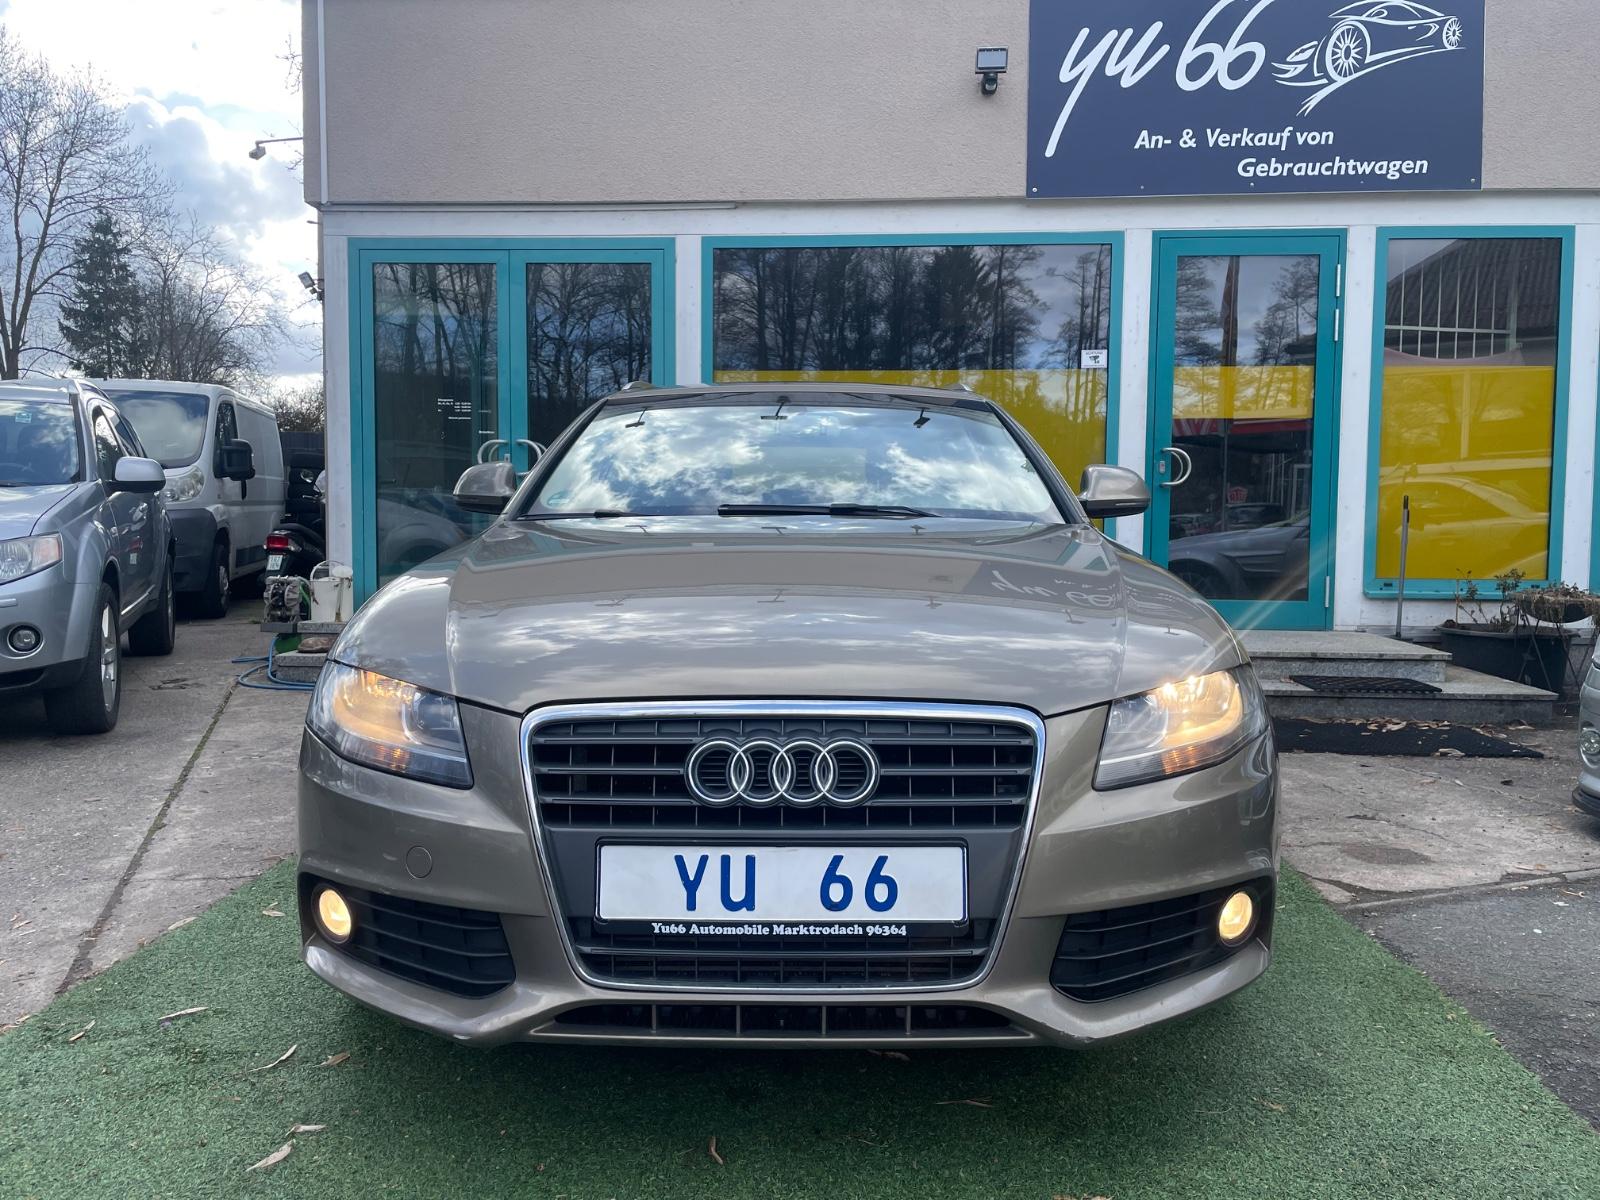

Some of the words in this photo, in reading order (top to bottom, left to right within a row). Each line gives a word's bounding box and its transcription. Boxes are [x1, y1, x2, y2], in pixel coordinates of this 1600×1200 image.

[1175, 0, 1275, 91] 66
[1133, 129, 1172, 149] An-
[1179, 128, 1197, 148] &
[1206, 126, 1293, 151] Verkauf
[1296, 131, 1334, 146] von
[1237, 156, 1429, 180] Gebrauchtwagen
[674, 854, 757, 913] YU
[819, 854, 899, 913] 66
[651, 922, 687, 935] Yu66
[688, 923, 770, 936] Automobile
[772, 924, 863, 936] Marktrodach
[865, 925, 907, 937] 96364
